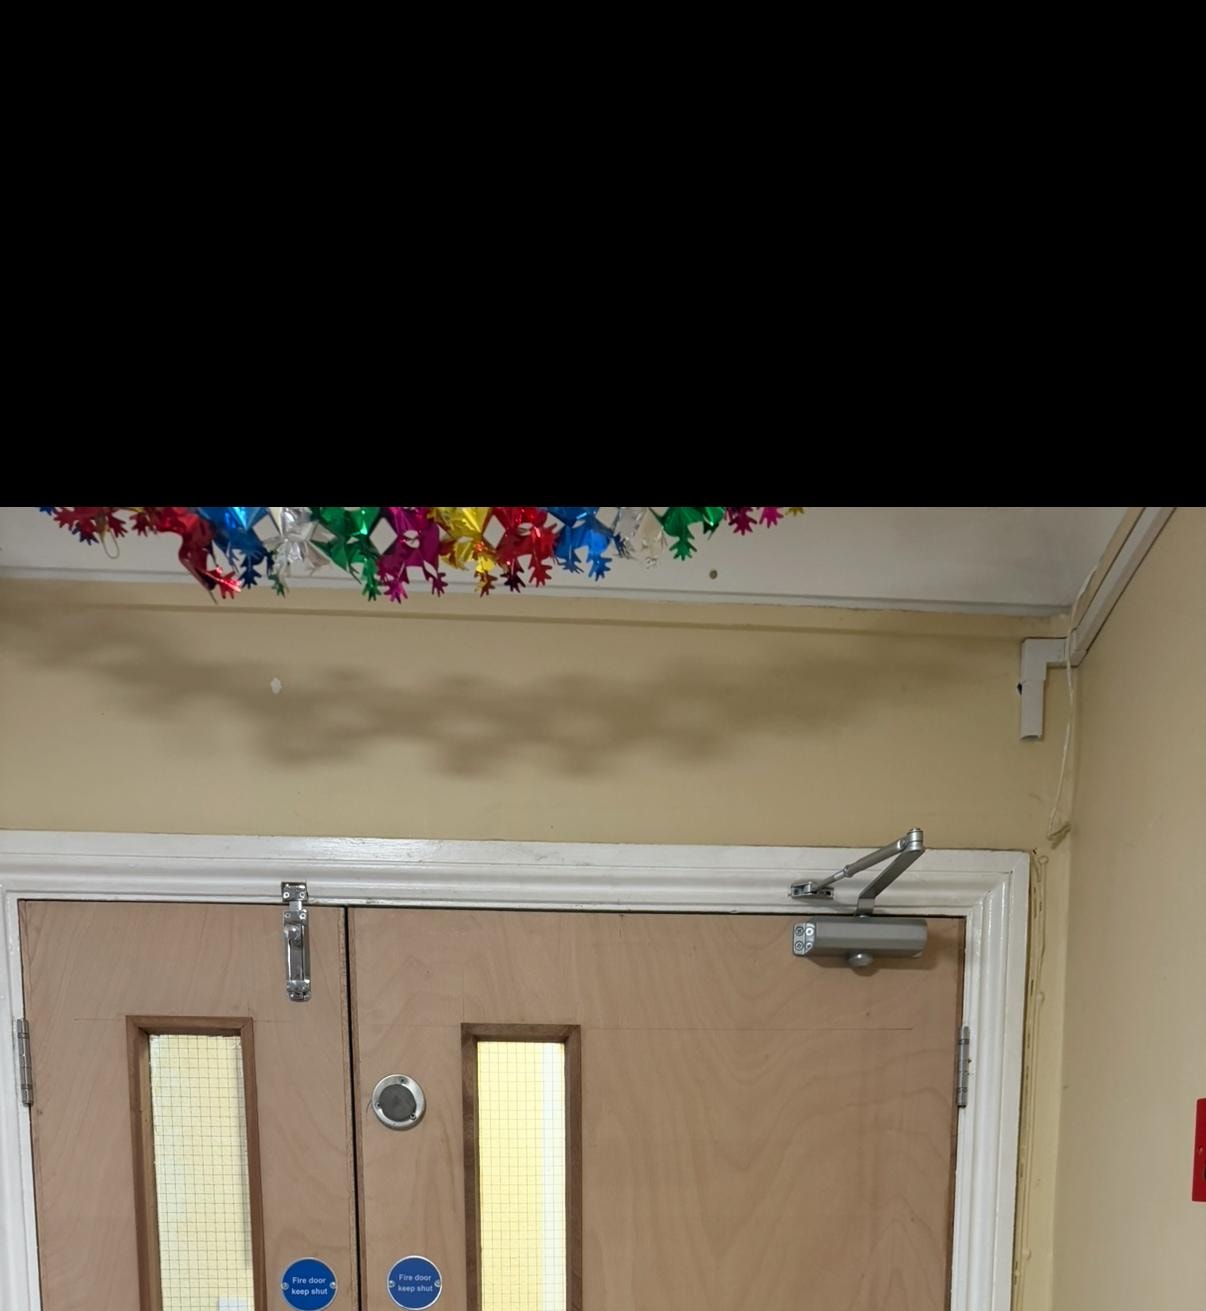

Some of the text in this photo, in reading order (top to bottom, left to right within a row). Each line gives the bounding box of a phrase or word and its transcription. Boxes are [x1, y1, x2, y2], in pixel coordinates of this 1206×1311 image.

[308, 1276, 326, 1284] door
[291, 1288, 310, 1296] keep
[398, 1285, 415, 1293] keep
